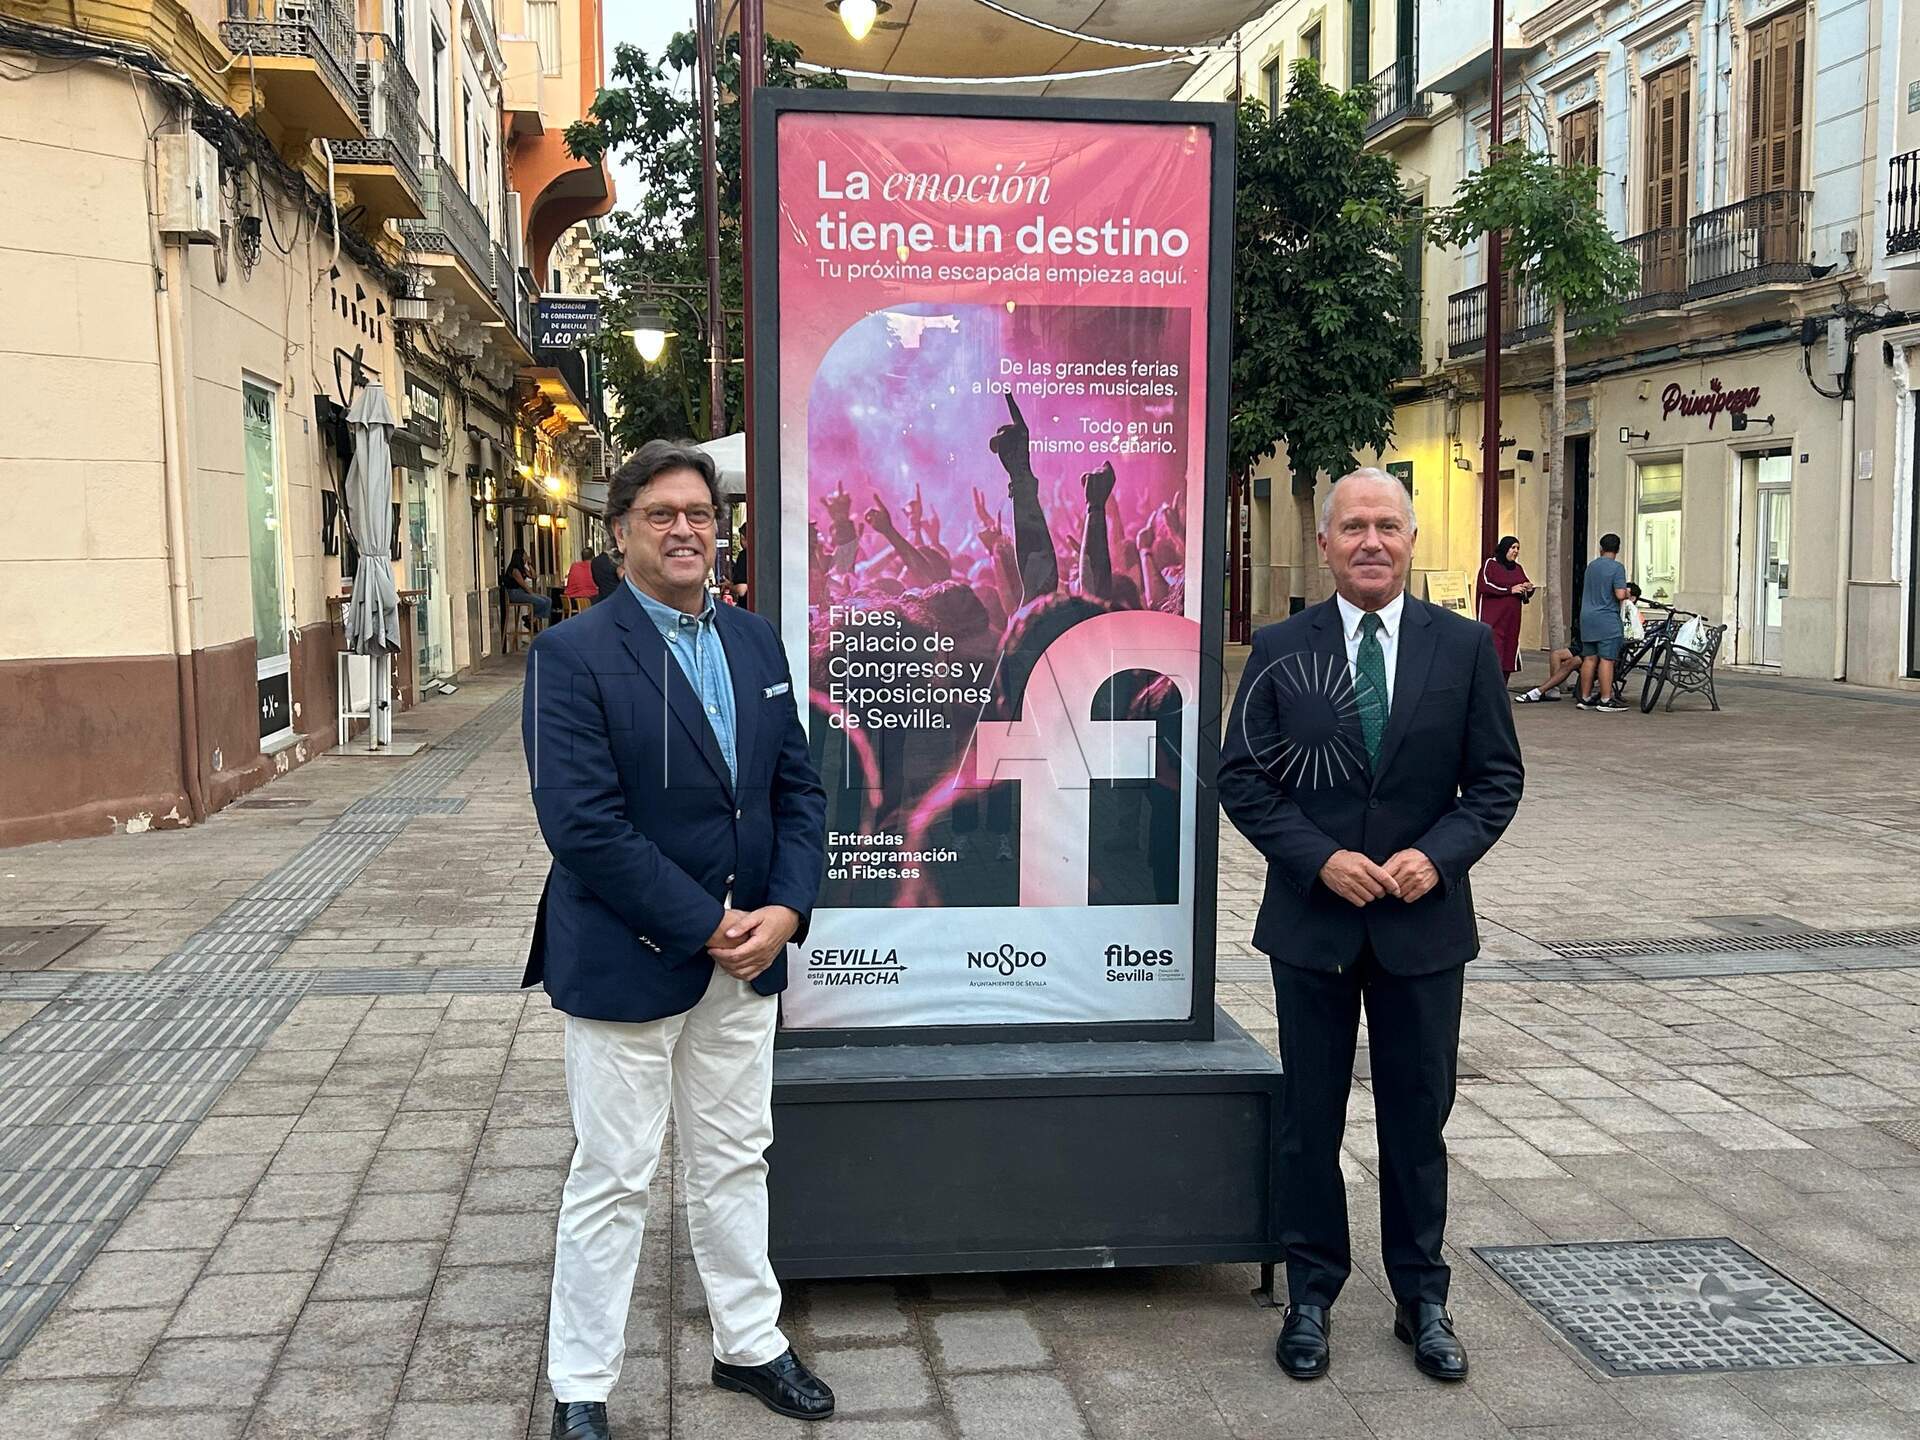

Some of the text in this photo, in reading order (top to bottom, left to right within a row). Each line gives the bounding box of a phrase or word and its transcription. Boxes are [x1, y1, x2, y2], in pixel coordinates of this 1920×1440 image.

[817, 160, 1051, 204] La emoción
[816, 210, 1190, 258] tiene un destino
[816, 258, 1188, 288] Tu próxima escapada empieza aquí.
[550, 312, 597, 320] COMERCIANTES
[560, 322, 587, 330] MELILLA
[1000, 358, 1179, 380] De las grandes ferias
[971, 378, 1178, 399] a los mejores musicales.
[1080, 417, 1173, 434] Todo en un
[1029, 436, 1177, 454] mismo escenario.
[829, 605, 902, 629] Fibes,
[829, 631, 955, 652] Palacio de
[828, 656, 984, 683] Congresos y
[829, 682, 992, 708] Exposiciones
[828, 708, 951, 729] de Sevilla.
[828, 831, 904, 846] Entradas
[828, 847, 958, 867] y programación
[827, 865, 920, 879] en Fibes.es
[809, 949, 899, 966] SEVILLA
[1104, 944, 1174, 967] fibes
[807, 972, 825, 980] está
[825, 971, 900, 986] MARCHA
[1106, 969, 1154, 982] Sevilla
